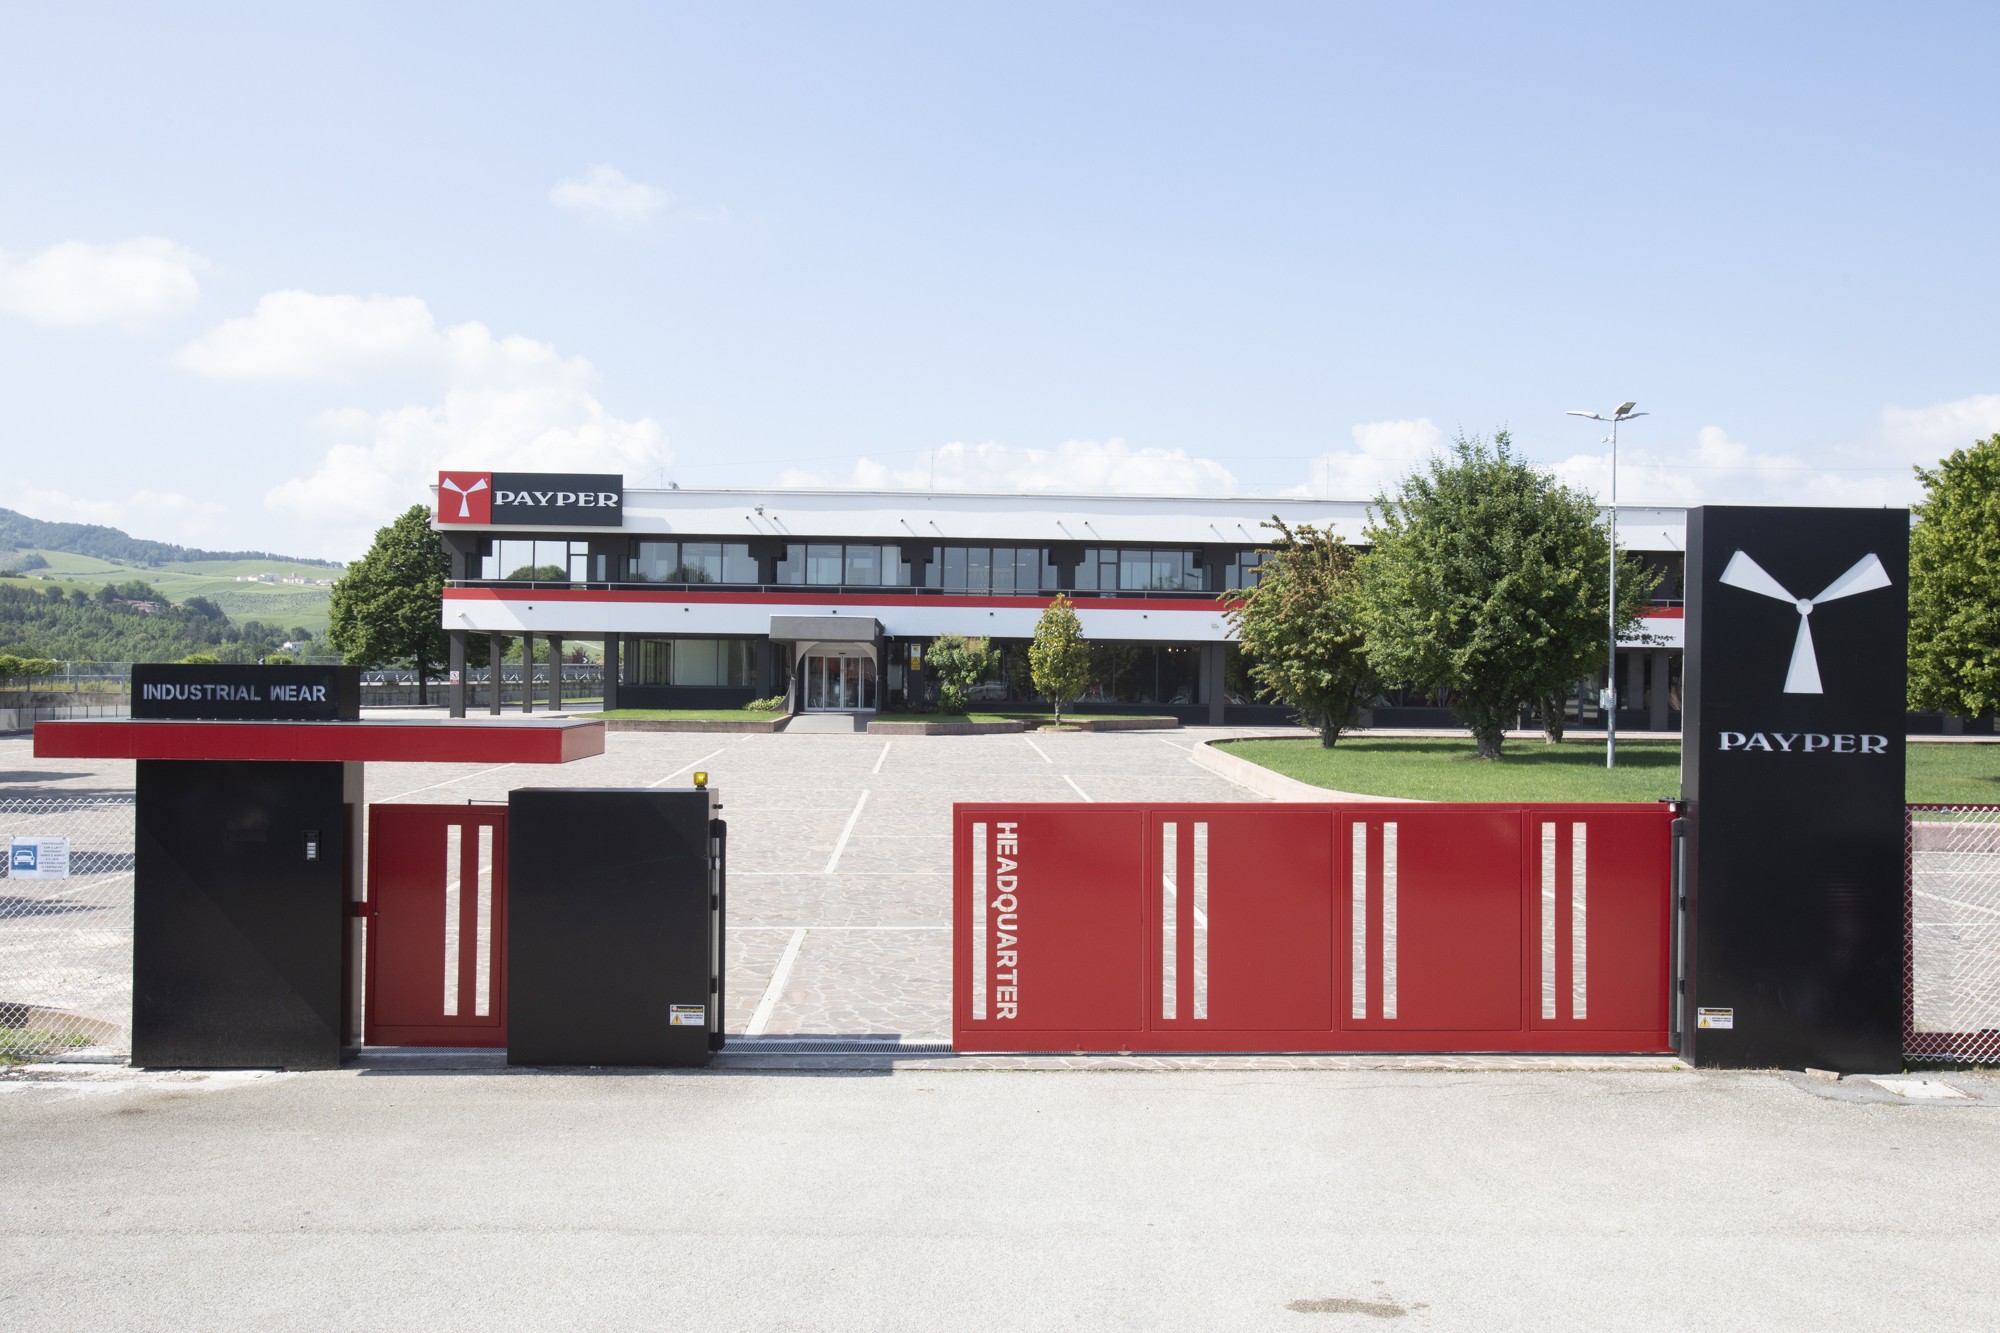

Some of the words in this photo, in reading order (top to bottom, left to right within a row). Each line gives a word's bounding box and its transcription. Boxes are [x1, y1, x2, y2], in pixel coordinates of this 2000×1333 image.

[494, 491, 619, 508] PAYPER
[143, 684, 261, 701] INDUSTRIAL
[270, 685, 326, 702] WEAR
[1718, 731, 1888, 754] PAYPER
[991, 822, 1018, 1020] HEADQUARTER
